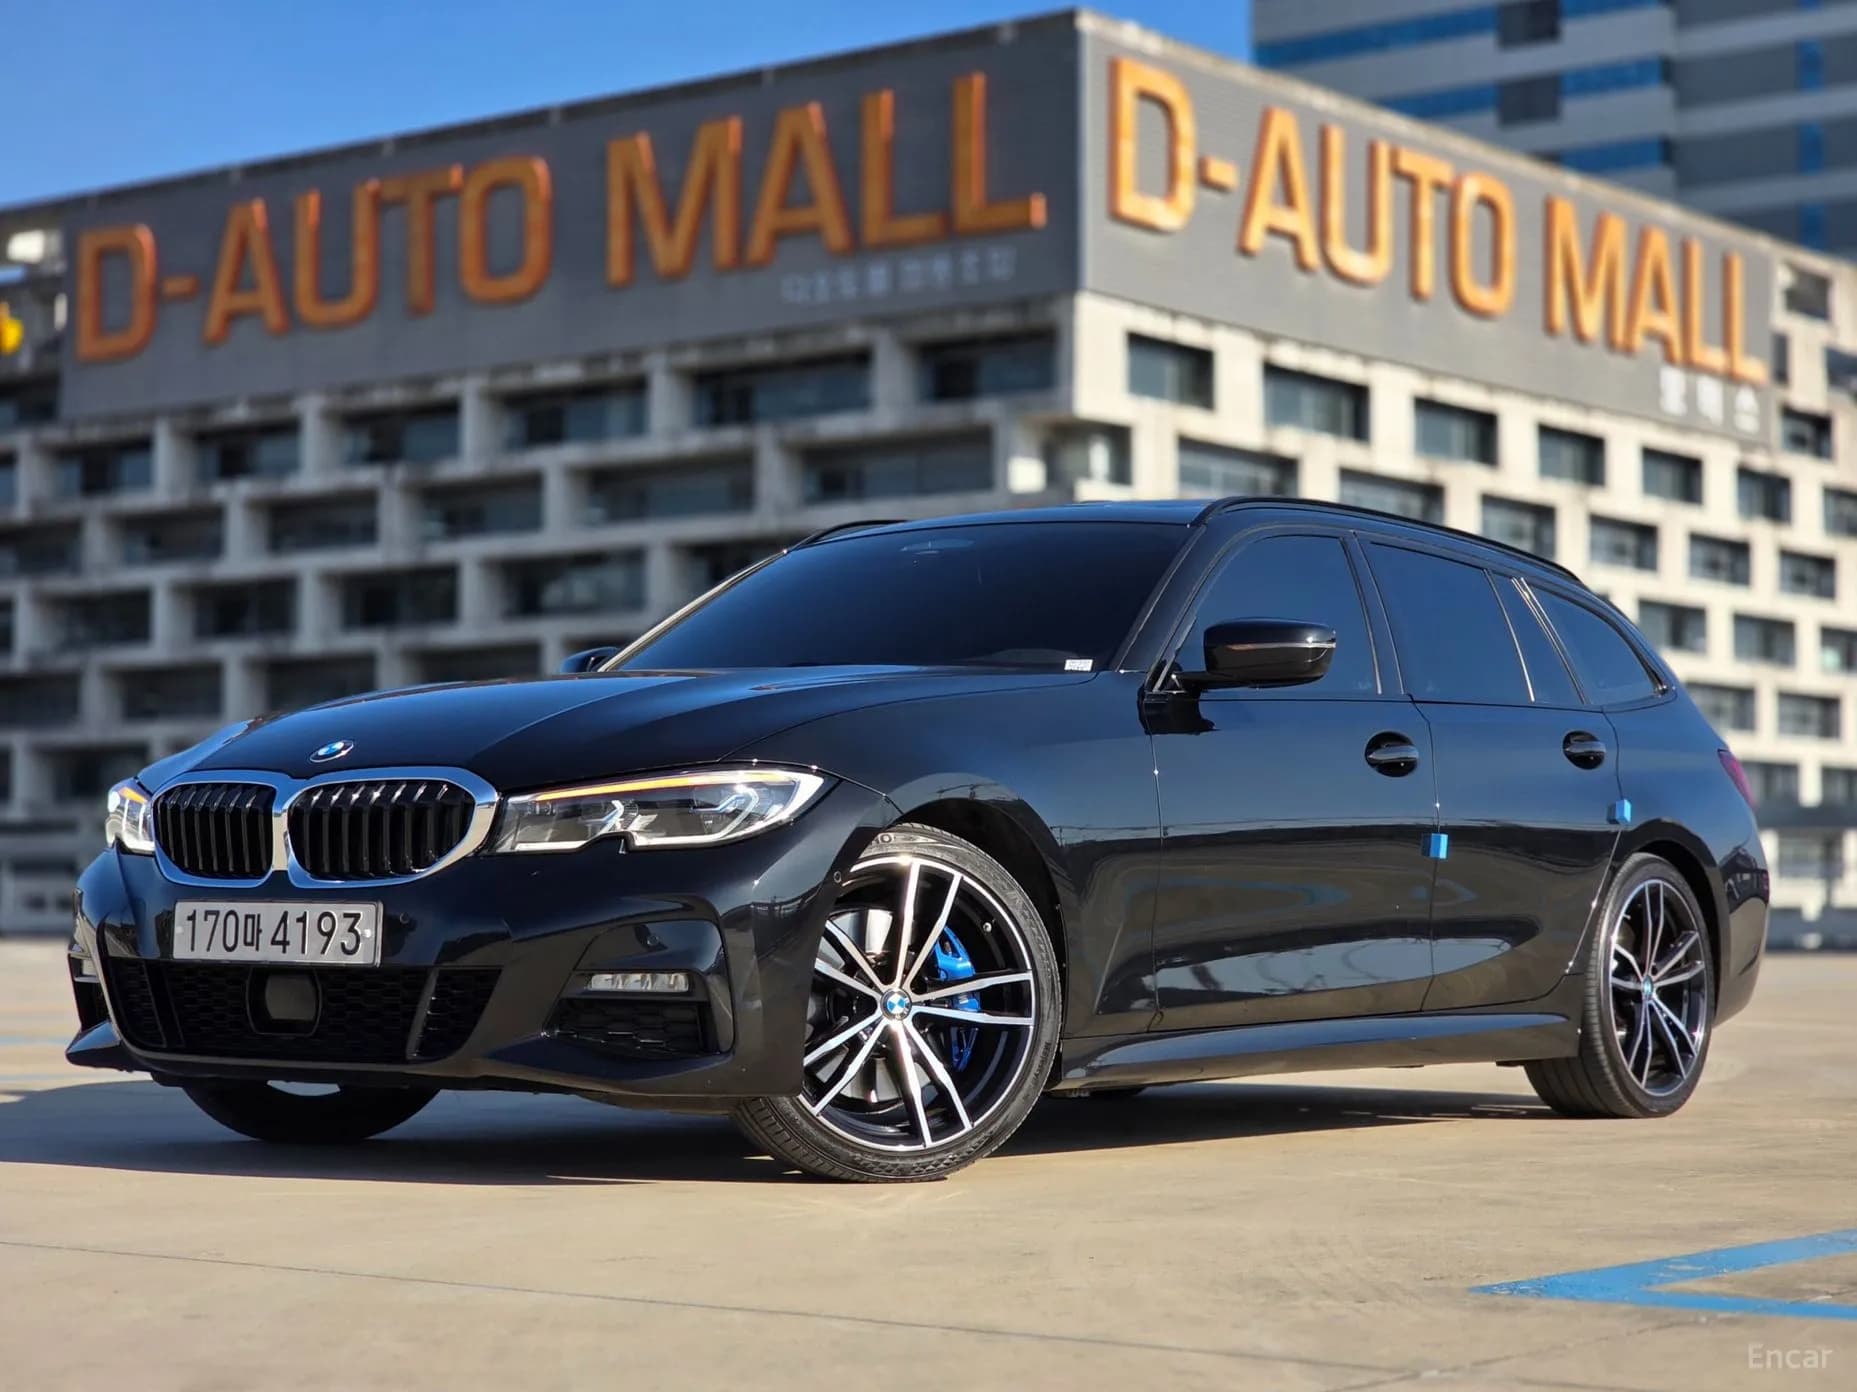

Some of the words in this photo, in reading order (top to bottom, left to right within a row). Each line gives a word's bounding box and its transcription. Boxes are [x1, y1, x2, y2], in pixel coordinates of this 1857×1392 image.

[76, 156, 551, 361] D-AUTO
[607, 72, 1047, 288] MALL
[1109, 56, 1517, 318] D-AUTO
[1545, 194, 1767, 383] MALL
